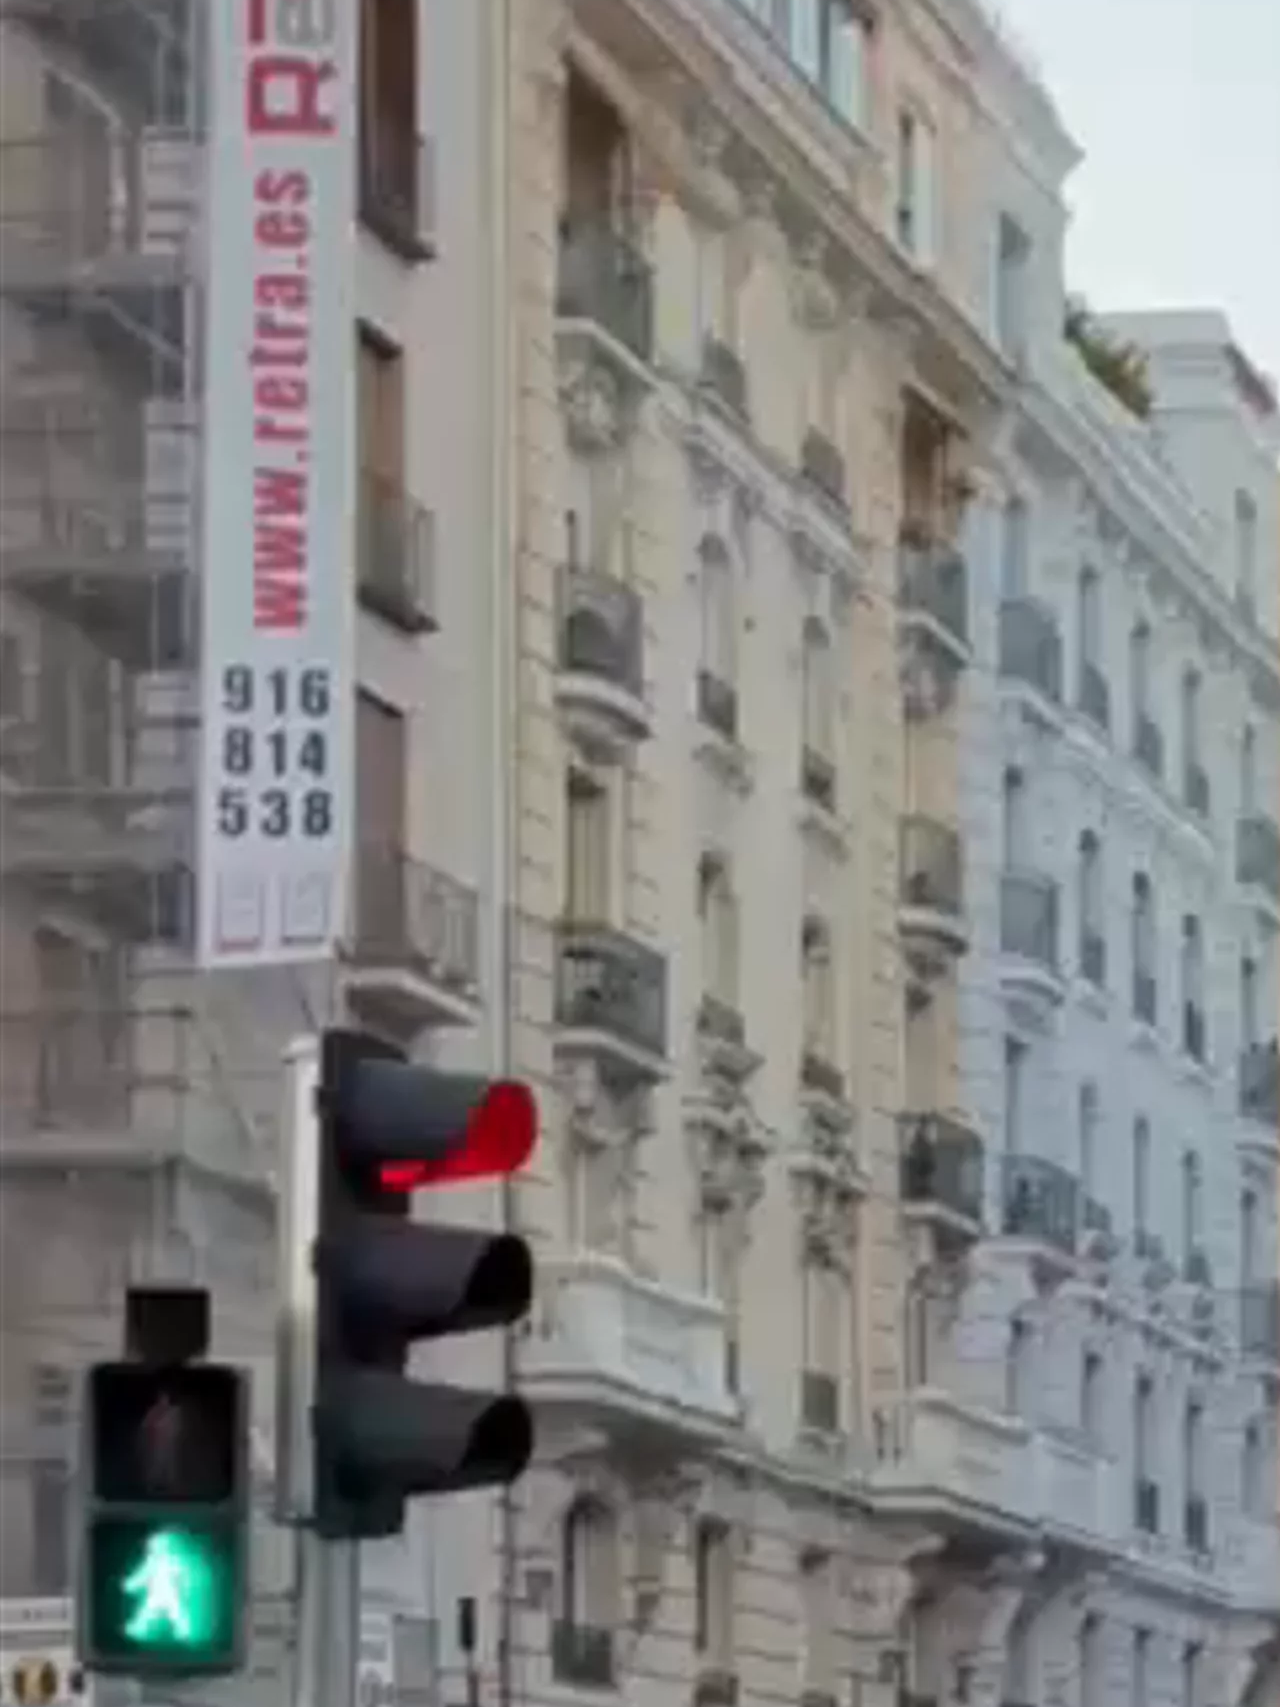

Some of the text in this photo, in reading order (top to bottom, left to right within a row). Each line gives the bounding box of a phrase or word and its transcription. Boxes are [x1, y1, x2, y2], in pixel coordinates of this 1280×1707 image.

[250, 168, 309, 628] www.retra.es
[222, 665, 330, 717] 916
[222, 727, 326, 777] 814
[217, 788, 332, 838] 538
